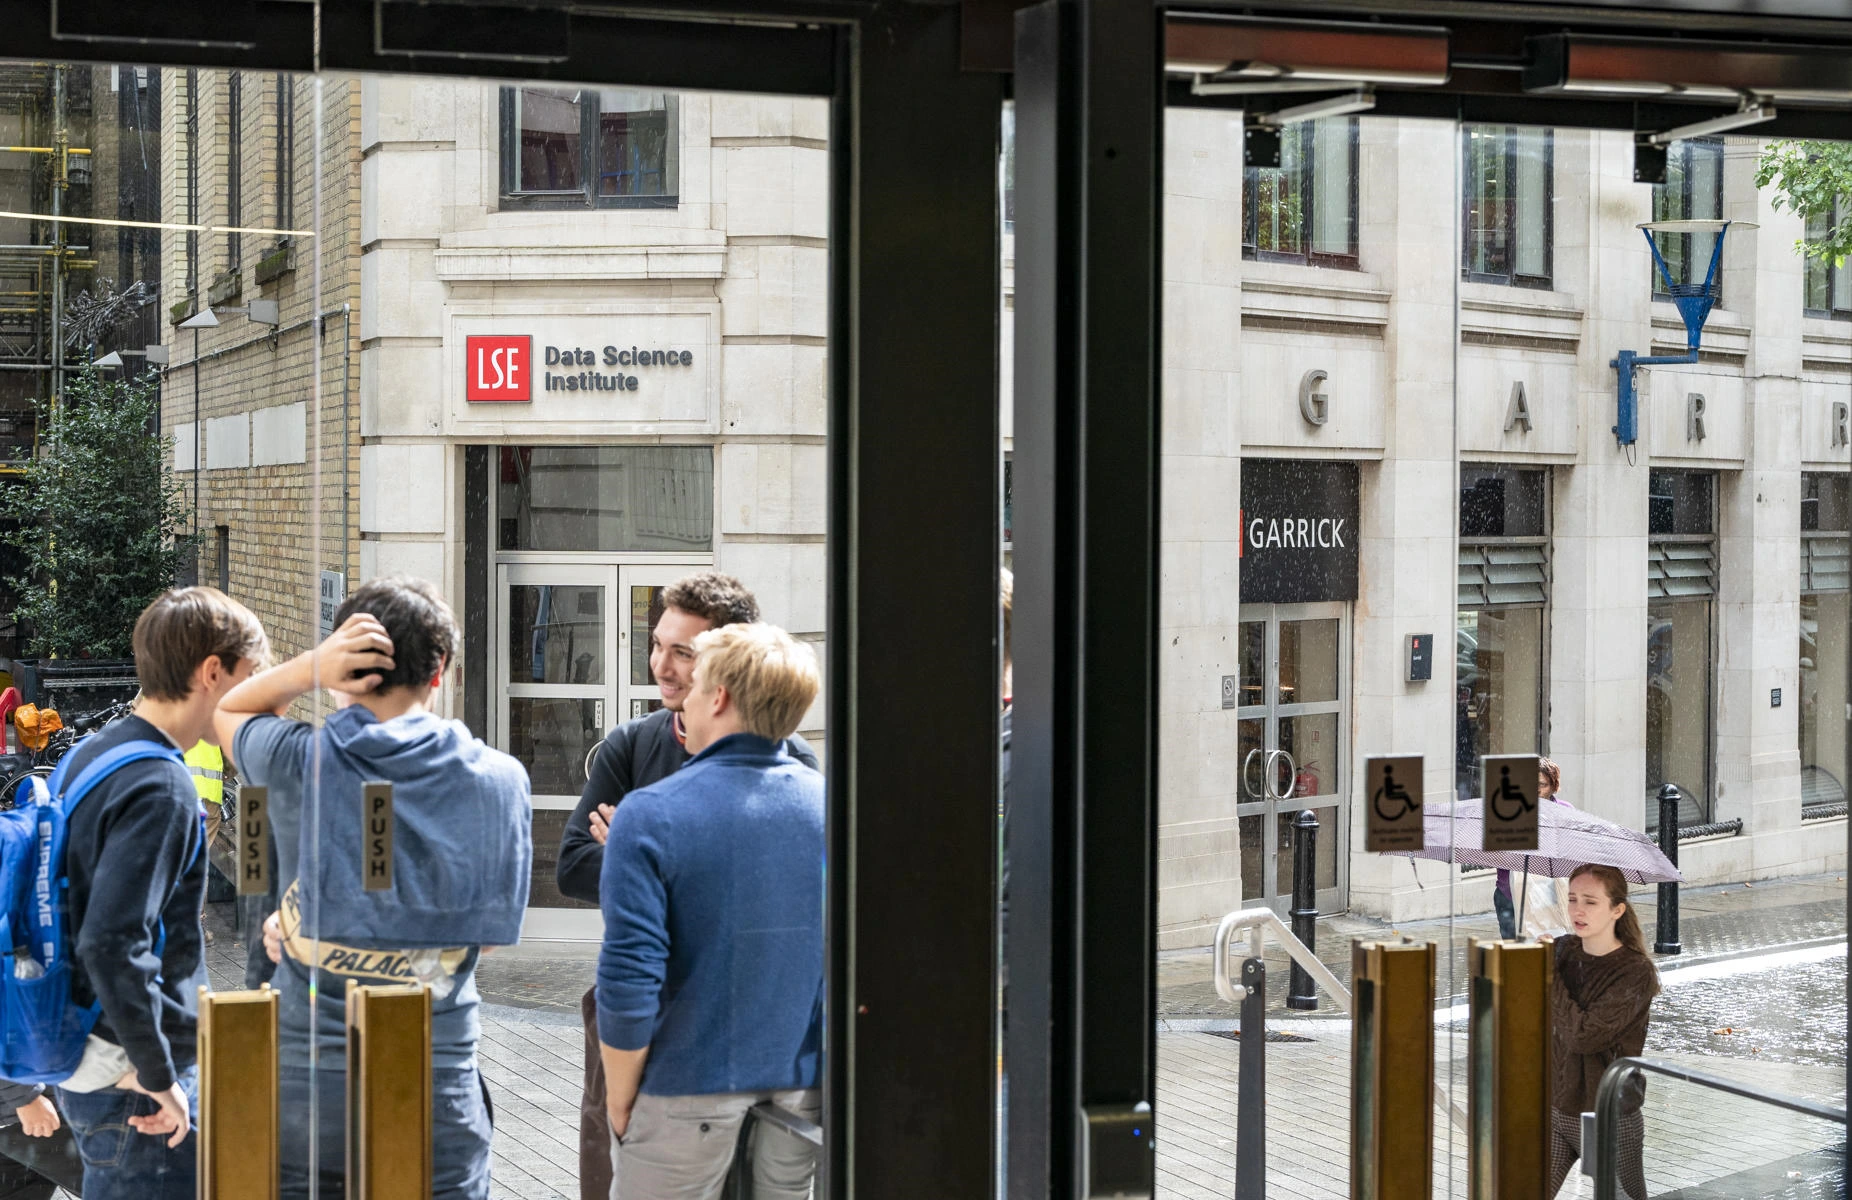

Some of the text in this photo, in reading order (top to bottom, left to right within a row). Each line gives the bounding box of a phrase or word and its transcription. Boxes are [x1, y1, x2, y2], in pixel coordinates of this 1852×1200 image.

[478, 348, 519, 389] LSE
[545, 345, 693, 366] Data Science
[545, 371, 639, 391] Institute
[1249, 517, 1345, 549] GARRICK
[246, 800, 261, 881] PUSH
[371, 797, 386, 877] PUSH
[36, 821, 53, 927] SUPREME
[322, 949, 414, 977] PALAC
